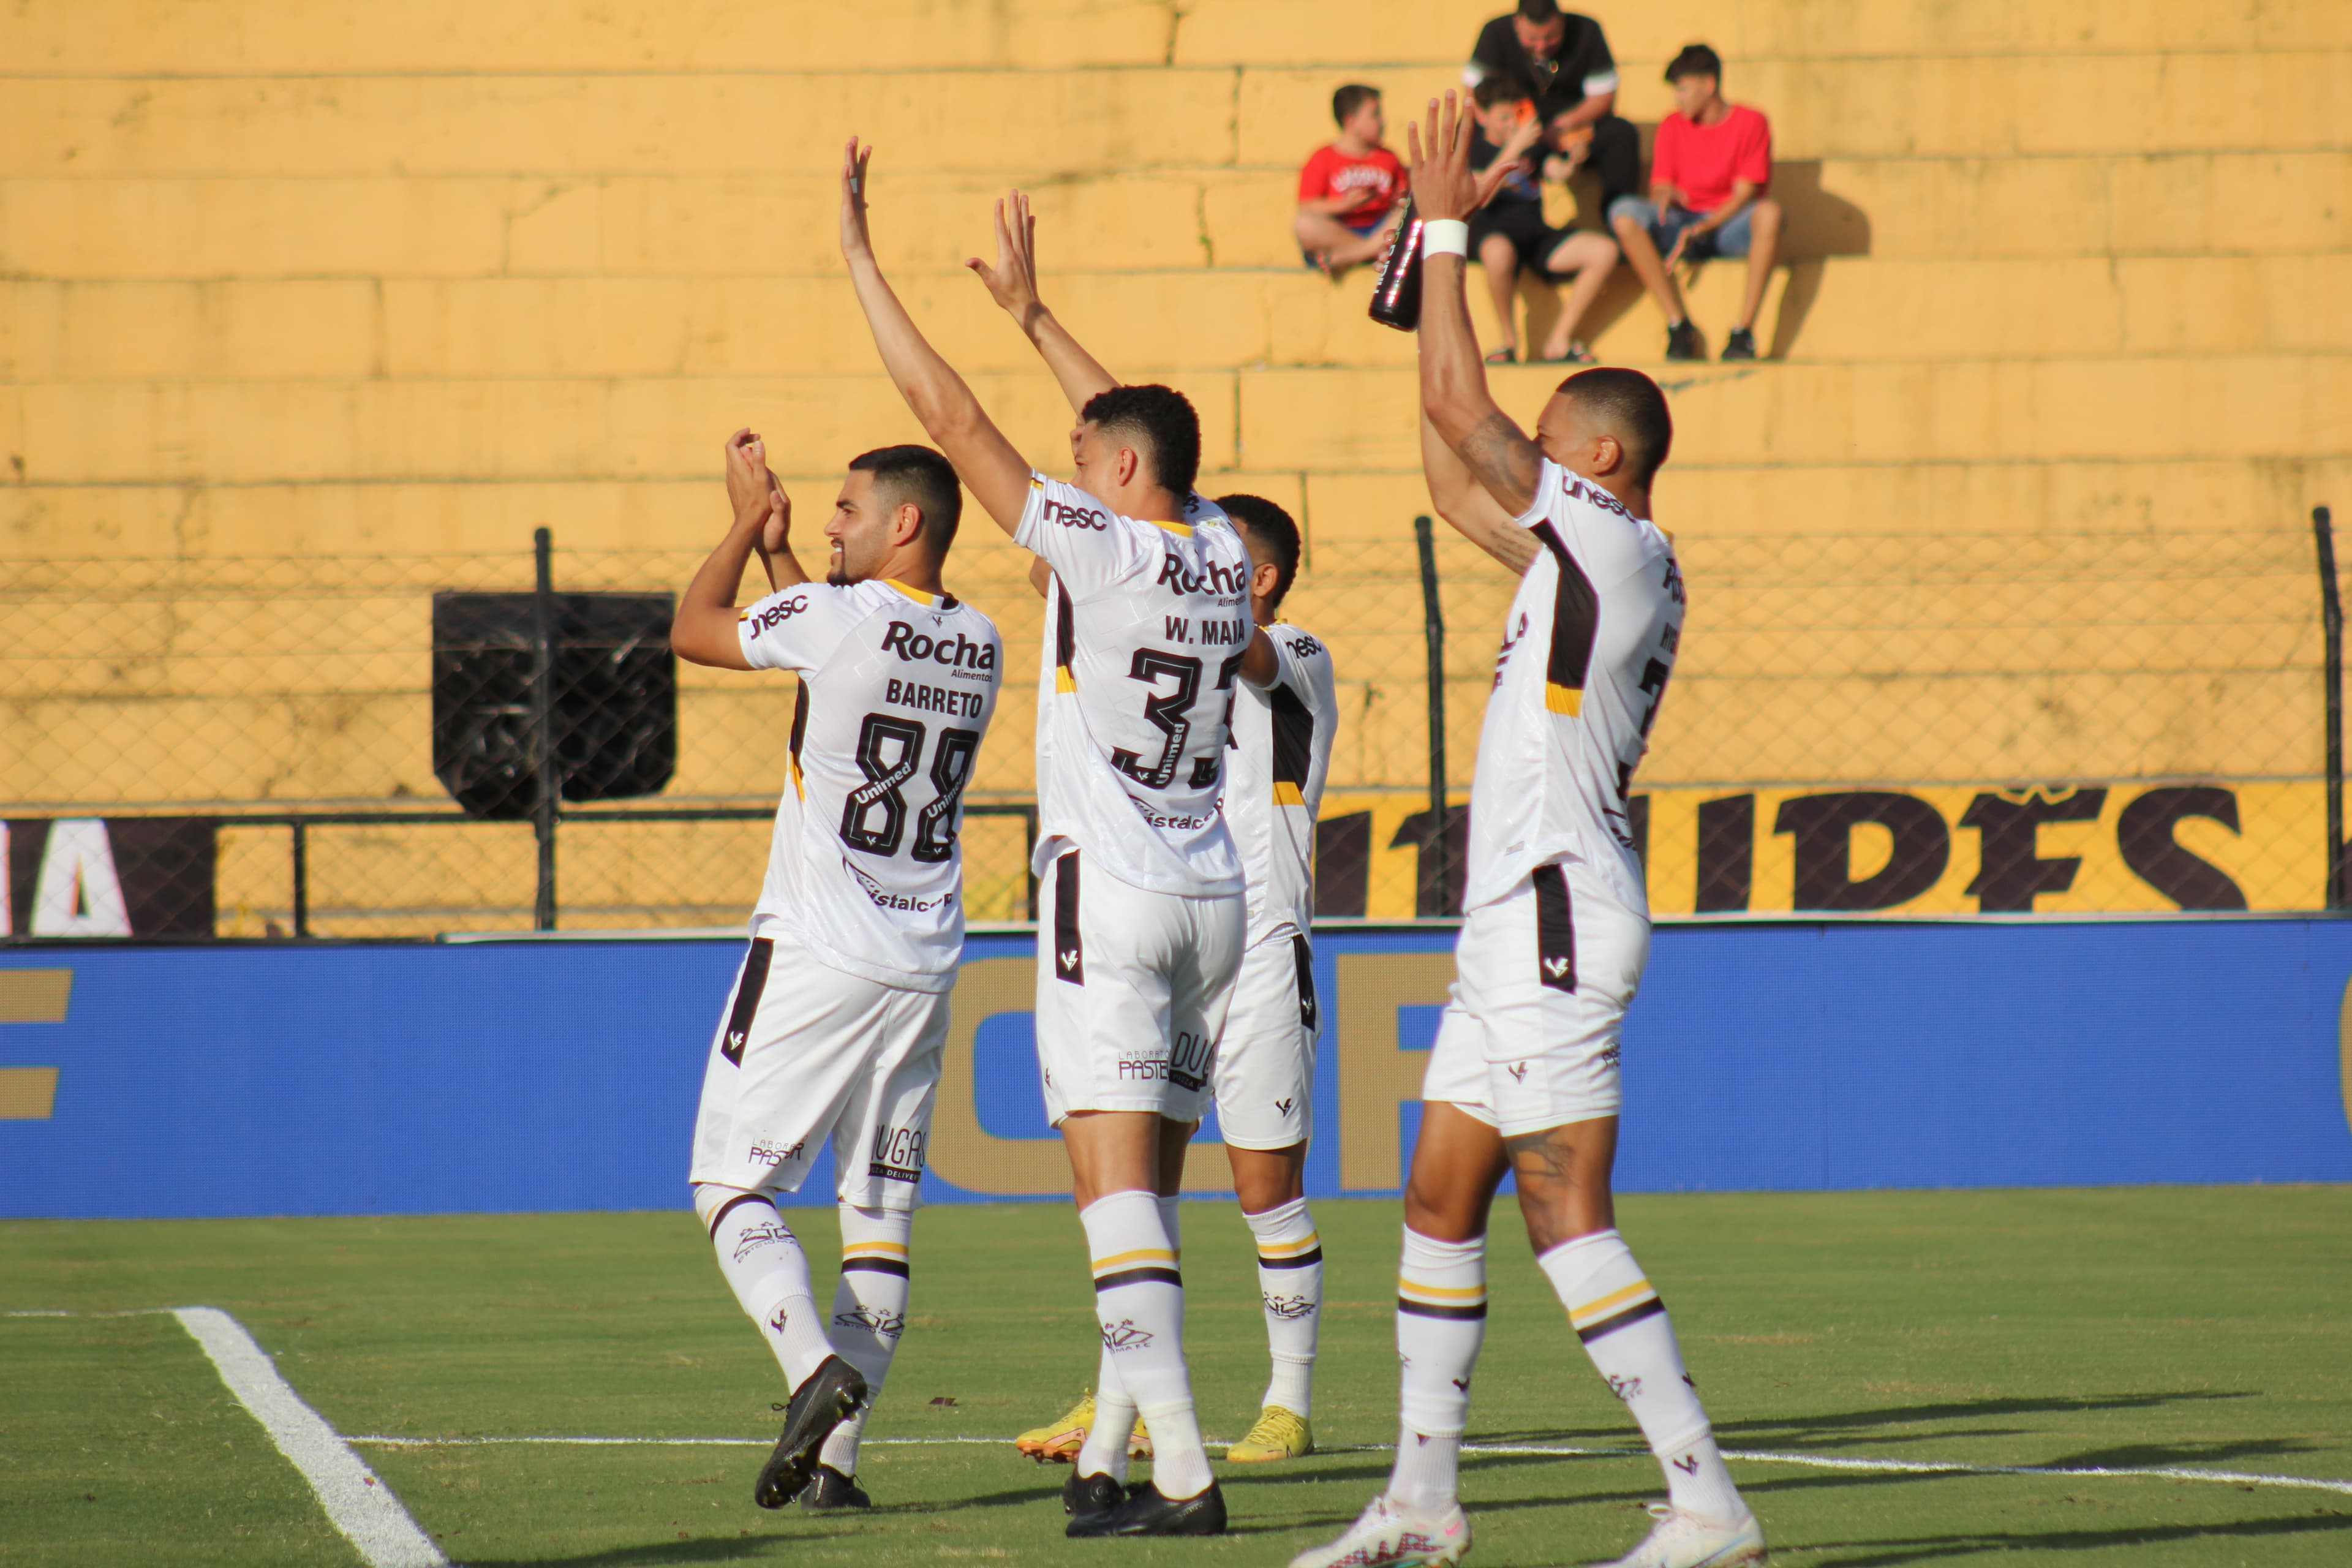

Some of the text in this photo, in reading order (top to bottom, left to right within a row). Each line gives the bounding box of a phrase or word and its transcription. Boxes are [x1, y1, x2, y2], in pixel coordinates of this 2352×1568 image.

[1044, 499, 1107, 532] nesc
[881, 620, 995, 671] Rocha
[1166, 615, 1245, 645] W. MAIA
[951, 668, 993, 682] Alimentos
[886, 678, 984, 718] BARRETO
[1156, 723, 1186, 785] Unimed
[839, 712, 979, 864] 88
[854, 761, 913, 805] Unimed
